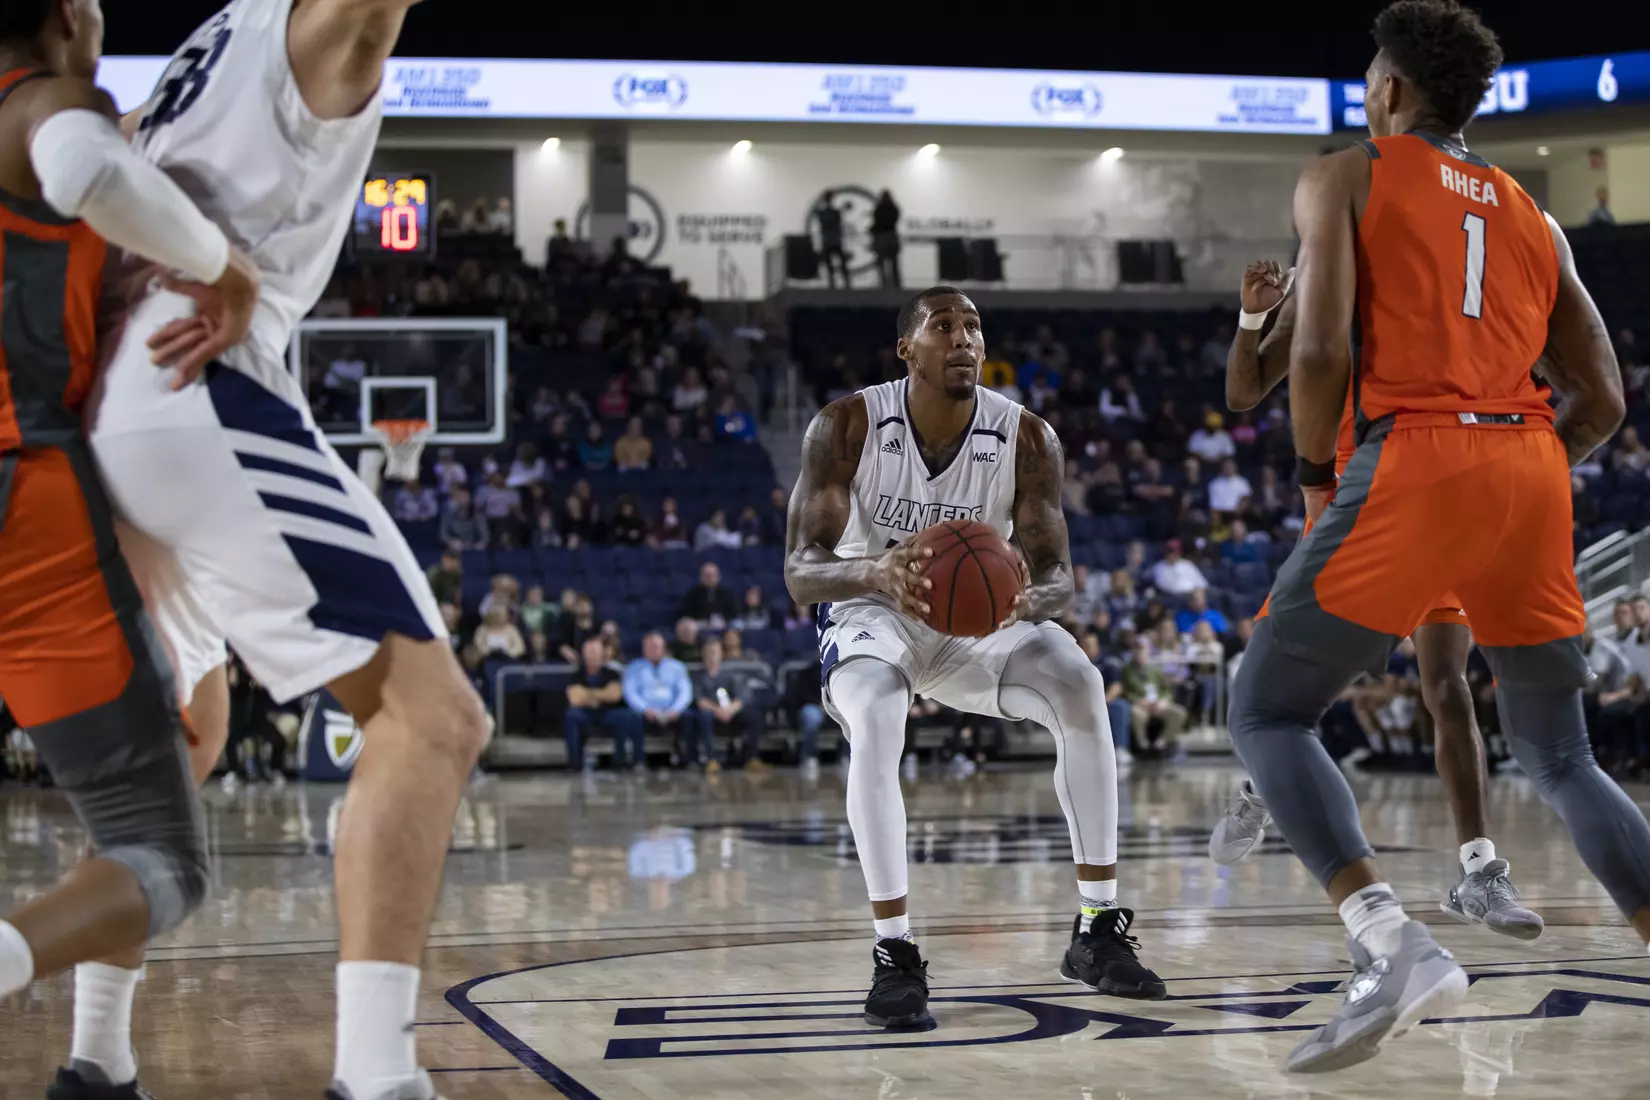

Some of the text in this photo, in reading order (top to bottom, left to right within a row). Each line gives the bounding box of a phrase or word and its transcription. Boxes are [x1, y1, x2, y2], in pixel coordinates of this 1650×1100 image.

[1597, 58, 1618, 102] 6
[1440, 163, 1499, 207] RHEA
[381, 206, 418, 251] 10
[1461, 210, 1487, 320] 1
[973, 452, 996, 463] WAC
